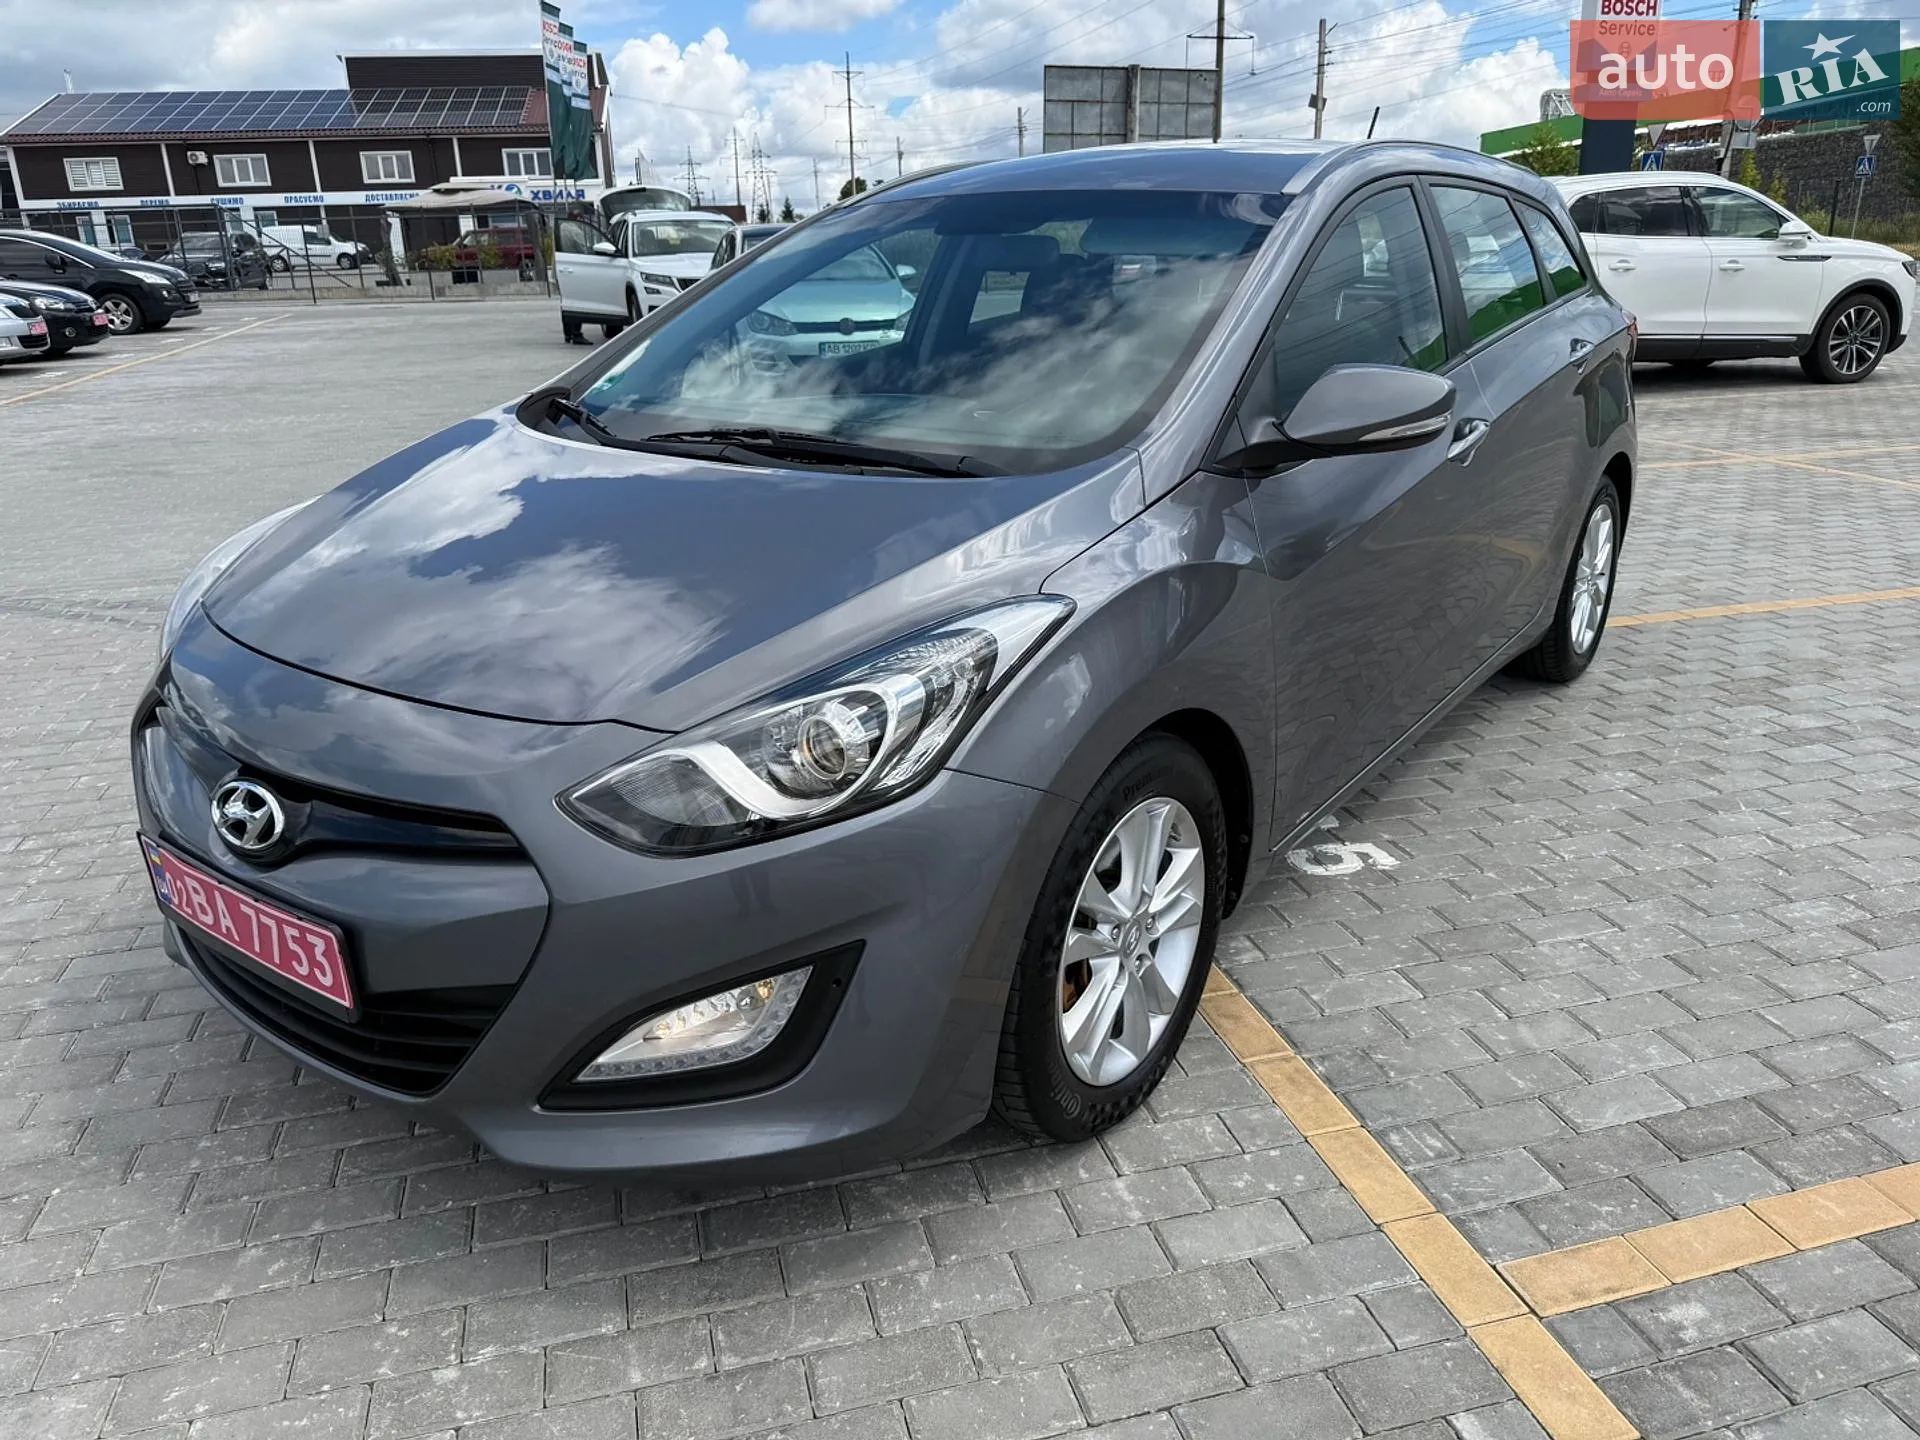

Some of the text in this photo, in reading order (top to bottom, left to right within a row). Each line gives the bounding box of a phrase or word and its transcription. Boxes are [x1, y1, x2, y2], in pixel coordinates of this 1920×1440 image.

[1600, 0, 1657, 16] BOSCH
[1598, 19, 1656, 36] Service
[531, 189, 585, 200] ХВИЛЯ
